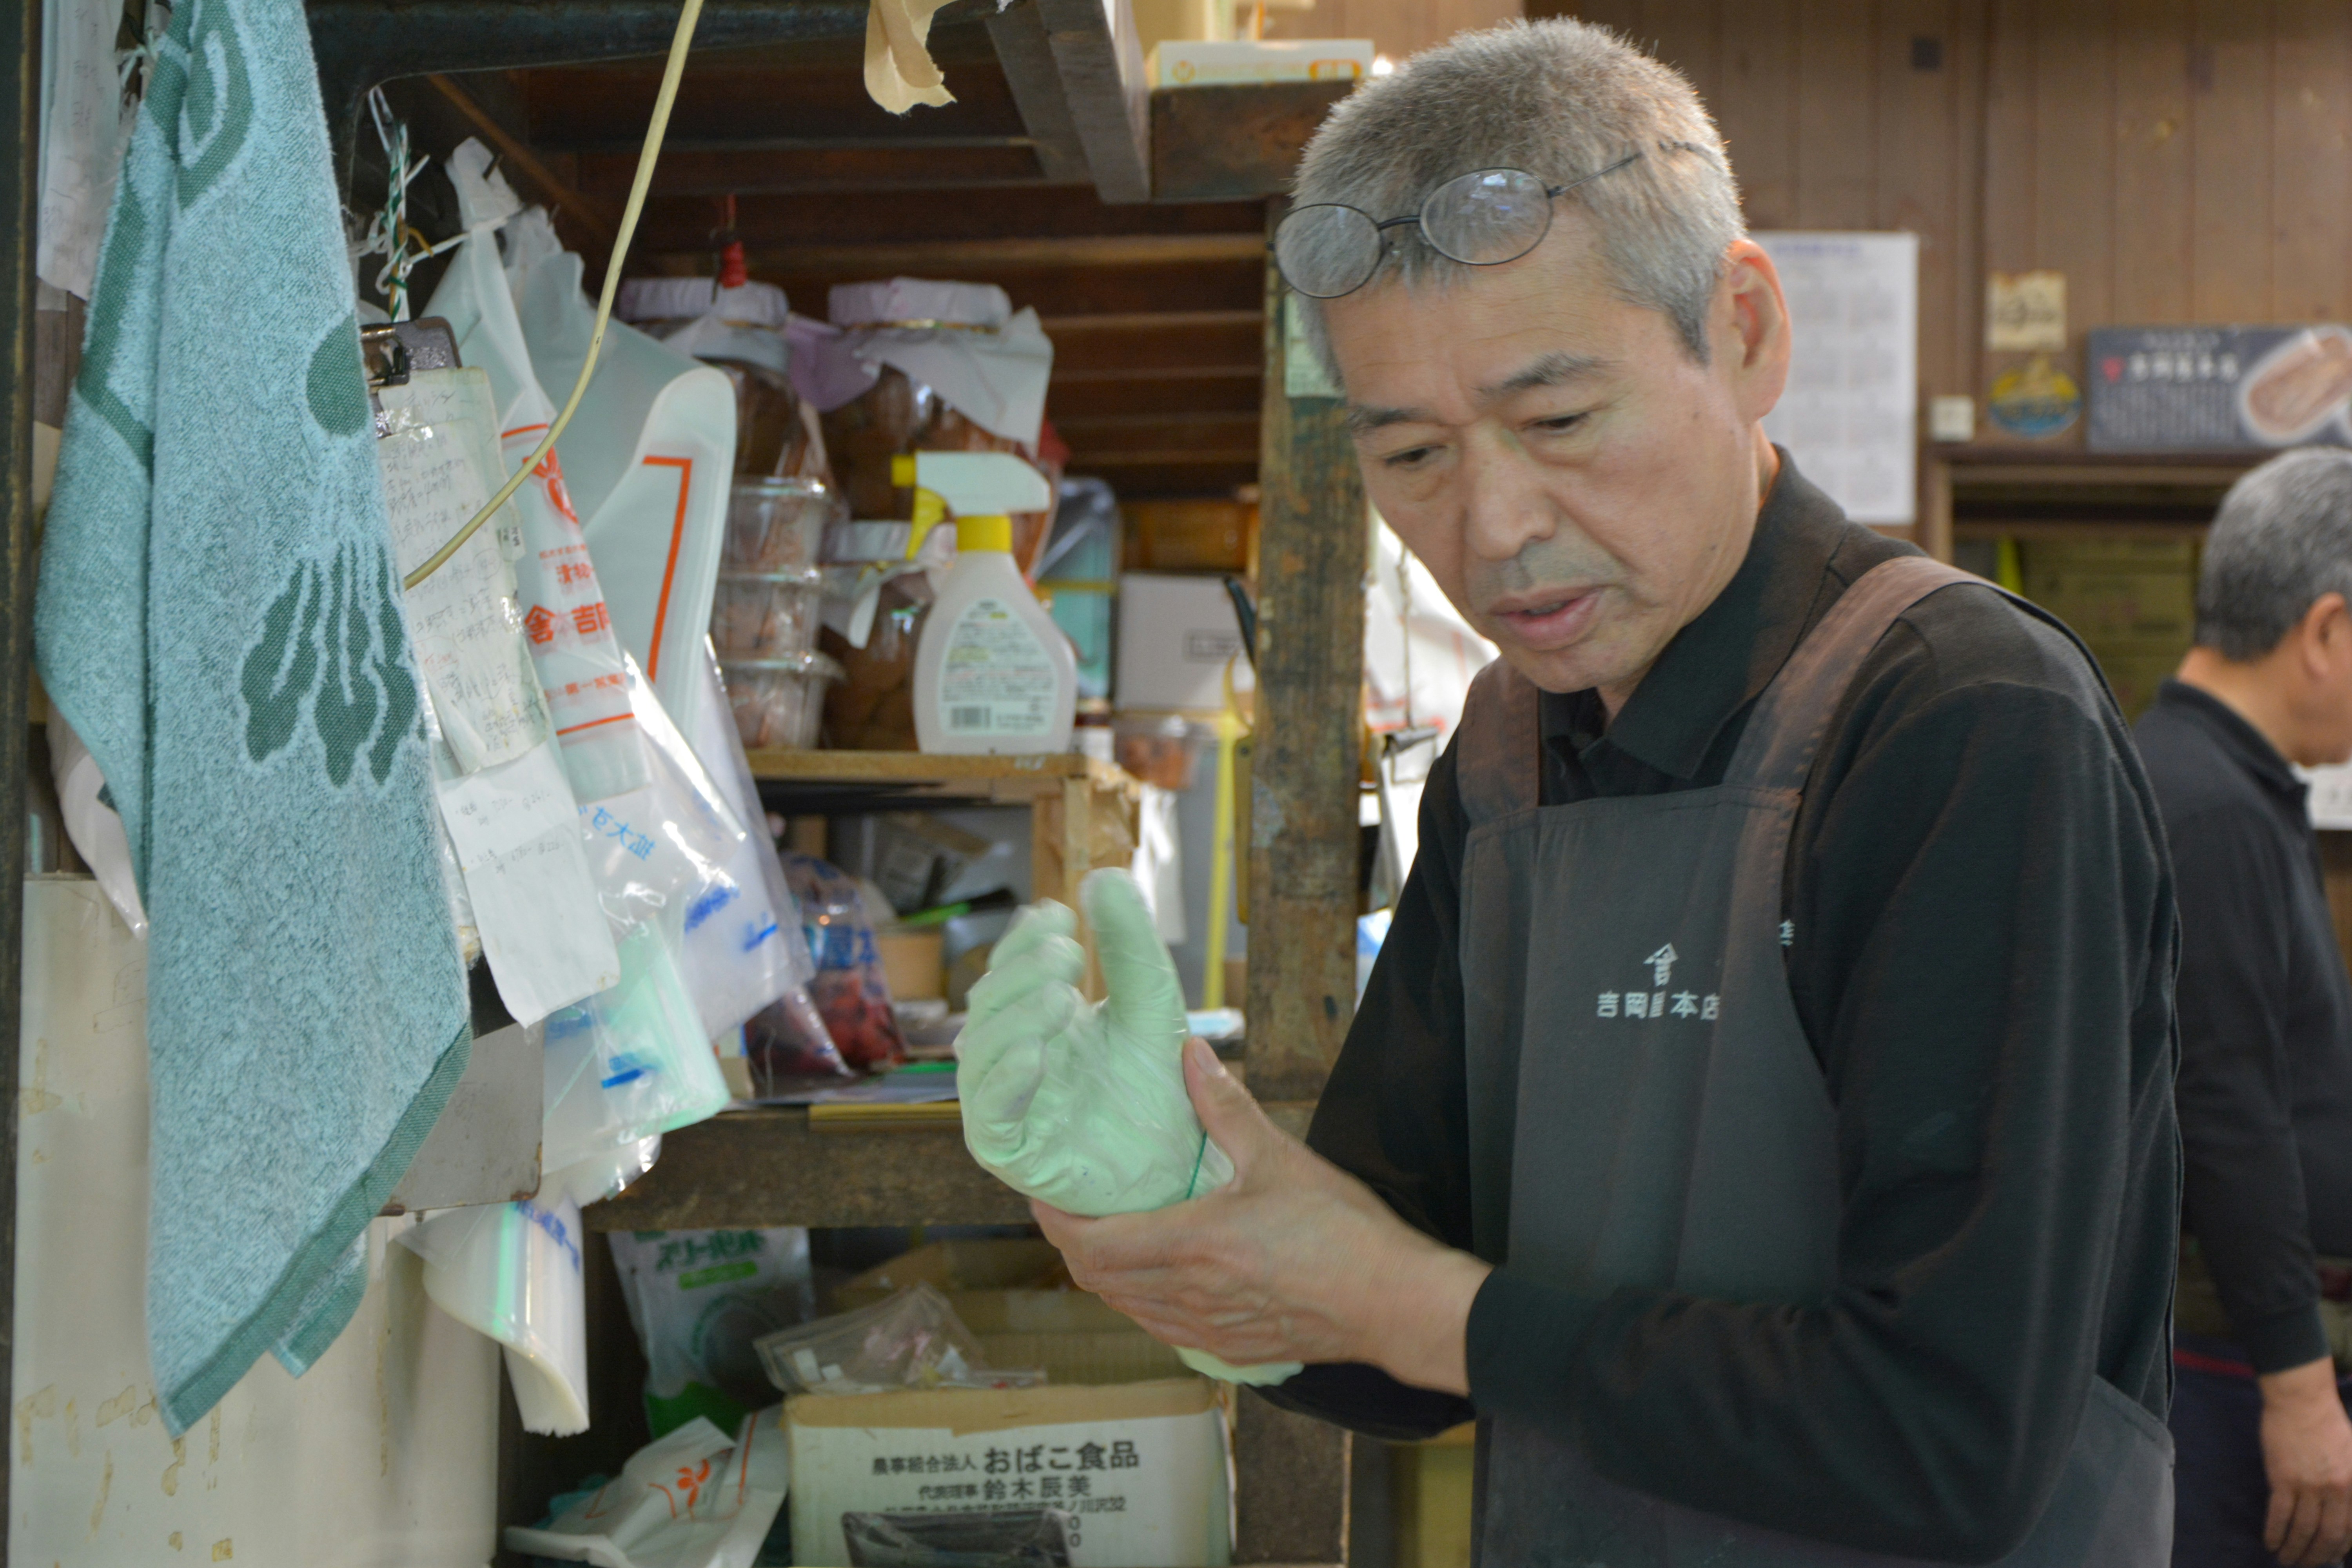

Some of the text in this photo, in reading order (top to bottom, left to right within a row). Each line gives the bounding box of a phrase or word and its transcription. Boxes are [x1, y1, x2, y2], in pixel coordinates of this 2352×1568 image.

[984, 1441, 1140, 1475] おばこ食品
